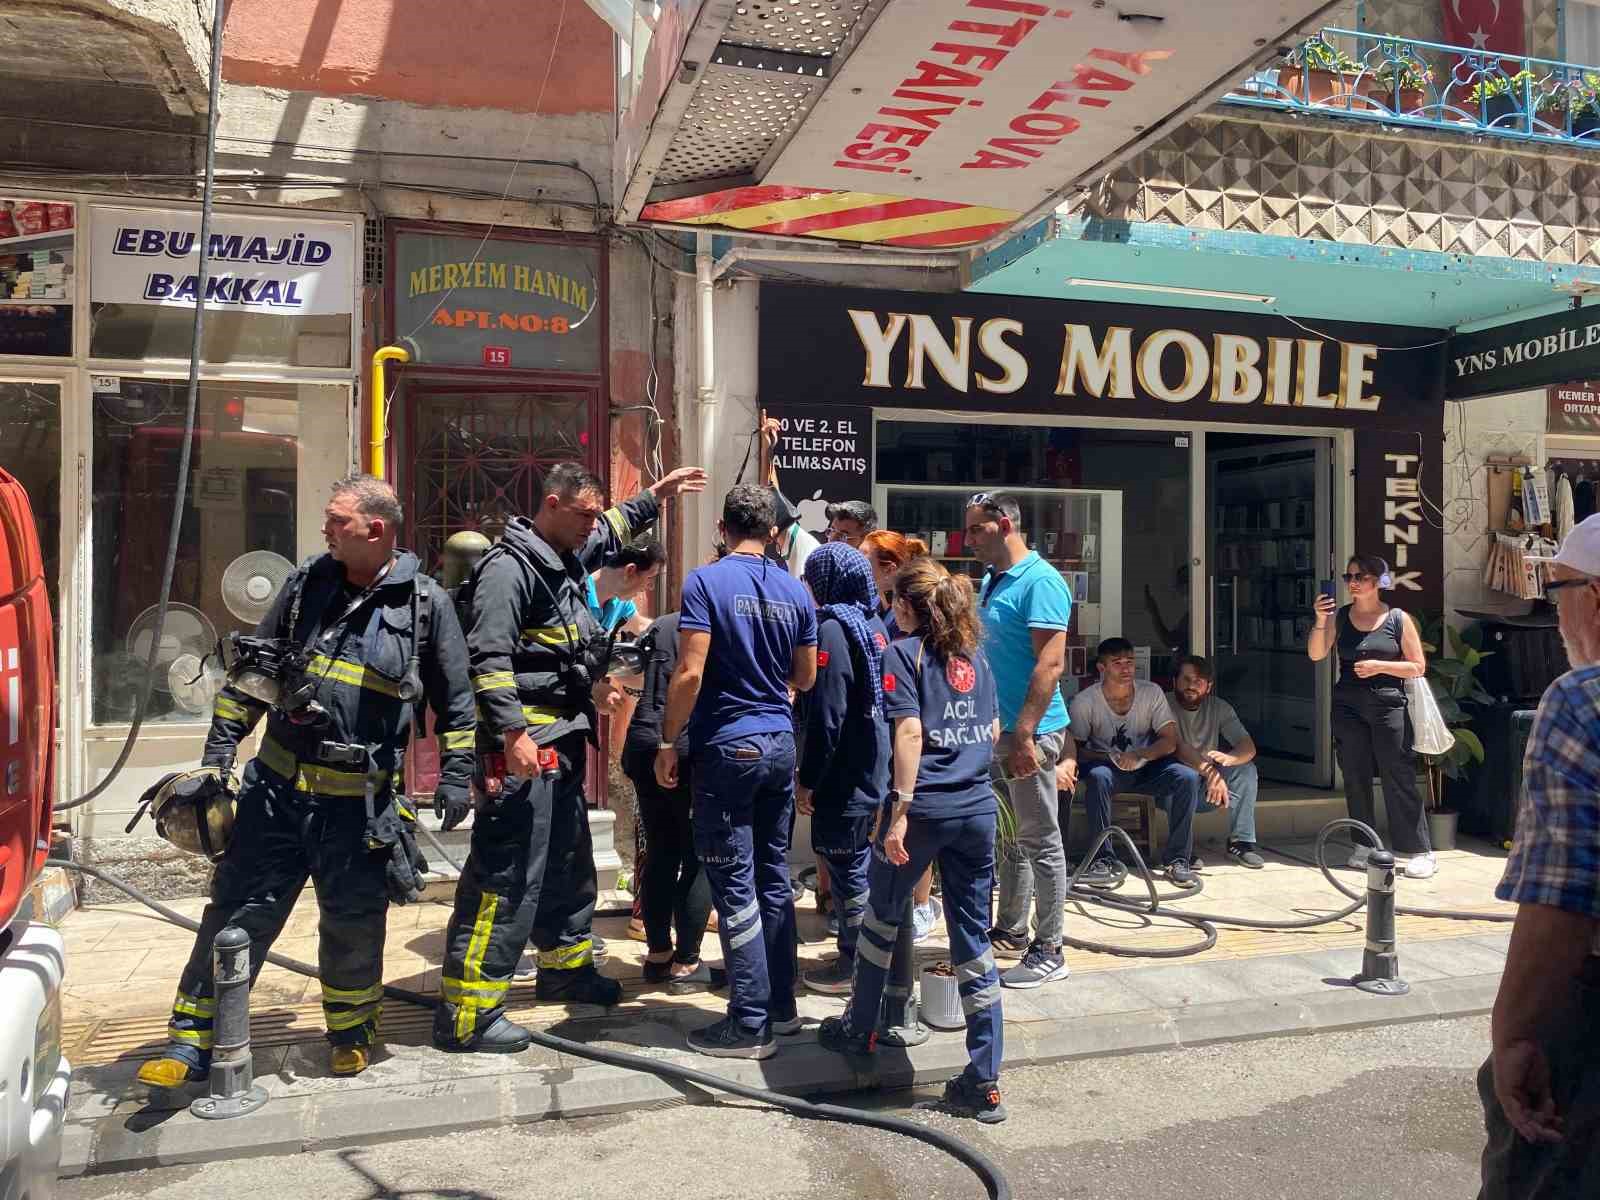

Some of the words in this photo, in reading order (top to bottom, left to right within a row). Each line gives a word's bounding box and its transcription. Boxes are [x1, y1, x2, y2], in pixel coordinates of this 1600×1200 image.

[833, 0, 1073, 174] İTFAİYESİ
[959, 48, 1176, 169] YALOVA
[112, 228, 195, 258] EBU
[206, 233, 332, 266] MAJİD
[143, 273, 304, 307] BAKKAL
[408, 262, 507, 298] MERYEM
[512, 264, 588, 312] HANIM
[489, 350, 505, 363] 15
[847, 309, 1030, 394] YNS
[1053, 322, 1383, 412] MOBILE
[1454, 350, 1497, 377] YNS
[1501, 323, 1600, 367] MOBİLE
[1558, 390, 1595, 402] KEMER
[793, 419, 815, 433] VE
[819, 420, 832, 434] 2.
[837, 421, 858, 435] EL
[781, 437, 856, 453] TELEFON
[772, 455, 866, 475] ALIM&SATIŞ
[943, 697, 977, 720] ACİL
[929, 723, 992, 747] SAĞLIK
